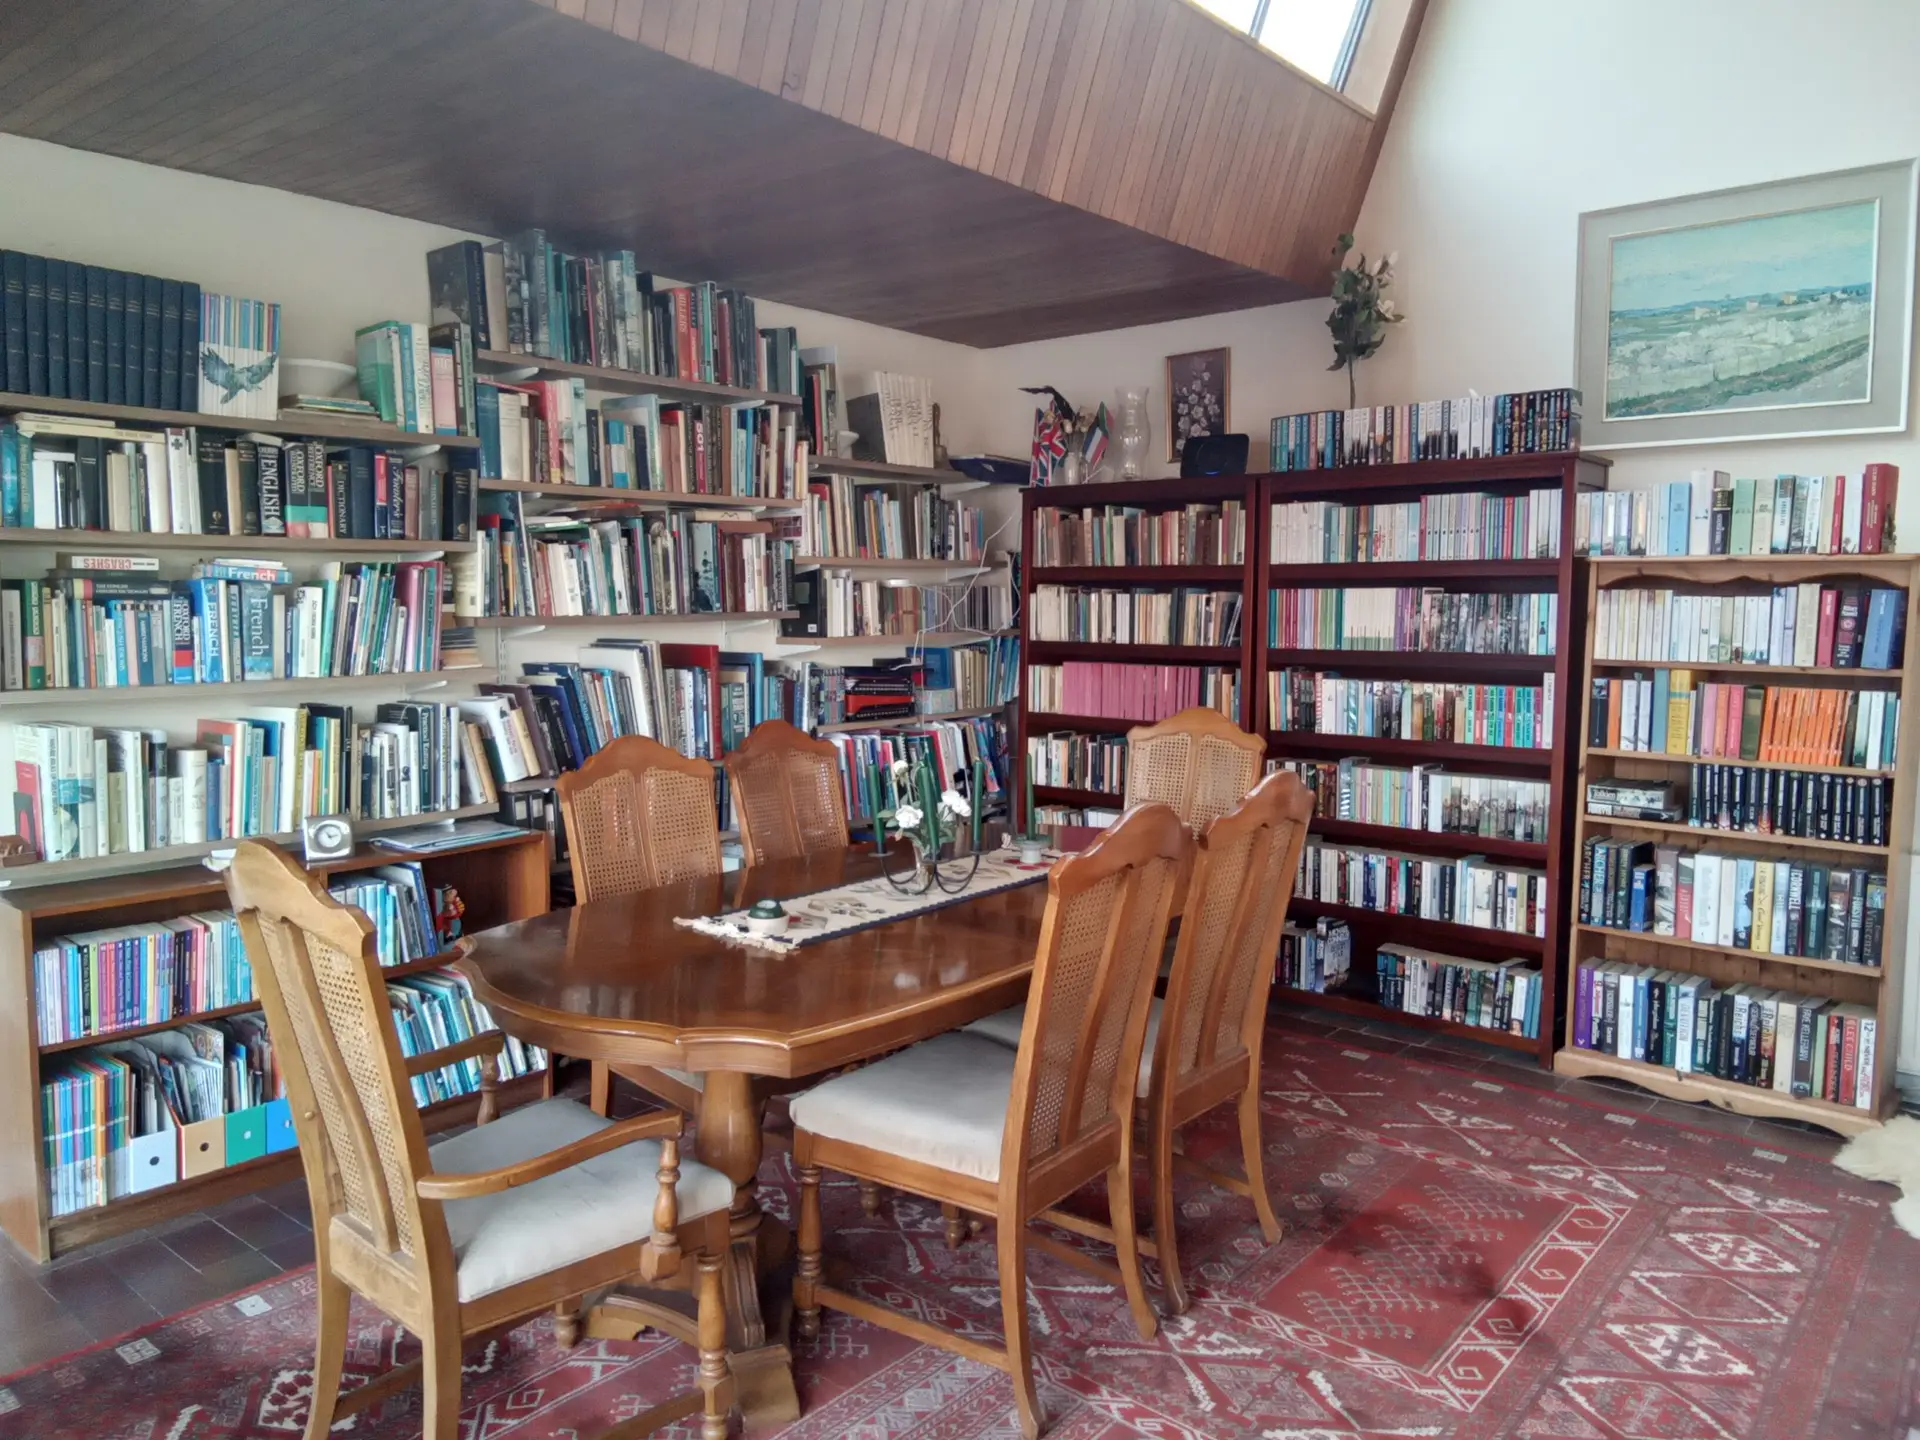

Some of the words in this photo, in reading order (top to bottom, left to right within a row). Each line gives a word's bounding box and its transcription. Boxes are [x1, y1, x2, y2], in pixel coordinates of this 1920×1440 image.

[696, 422, 705, 452] 501
[296, 449, 306, 493] OXFORD
[315, 443, 325, 488] OXFORD
[261, 458, 281, 517] ENGLISH
[336, 480, 347, 534] DICTIONARY
[83, 557, 132, 569] CRASHES
[227, 566, 277, 581] French
[173, 603, 182, 641] FRENCH
[182, 603, 191, 642] OXFORD
[207, 602, 220, 657] FRENCH
[250, 597, 270, 657] French
[422, 713, 430, 742] Practical
[422, 743, 431, 771] Knitting
[1584, 845, 1592, 879] ARCHER
[1594, 846, 1607, 885] ARCHER
[1788, 870, 1802, 910] CORNWELL
[1851, 896, 1863, 928] FORSYTH
[1863, 909, 1878, 957] Vincenzi
[1802, 1009, 1813, 1023] FAYE
[1846, 1026, 1855, 1040] LEE
[1863, 1021, 1875, 1033] 12
[1798, 1024, 1812, 1061] KELLERMAN
[1843, 1043, 1855, 1071] CHILD
